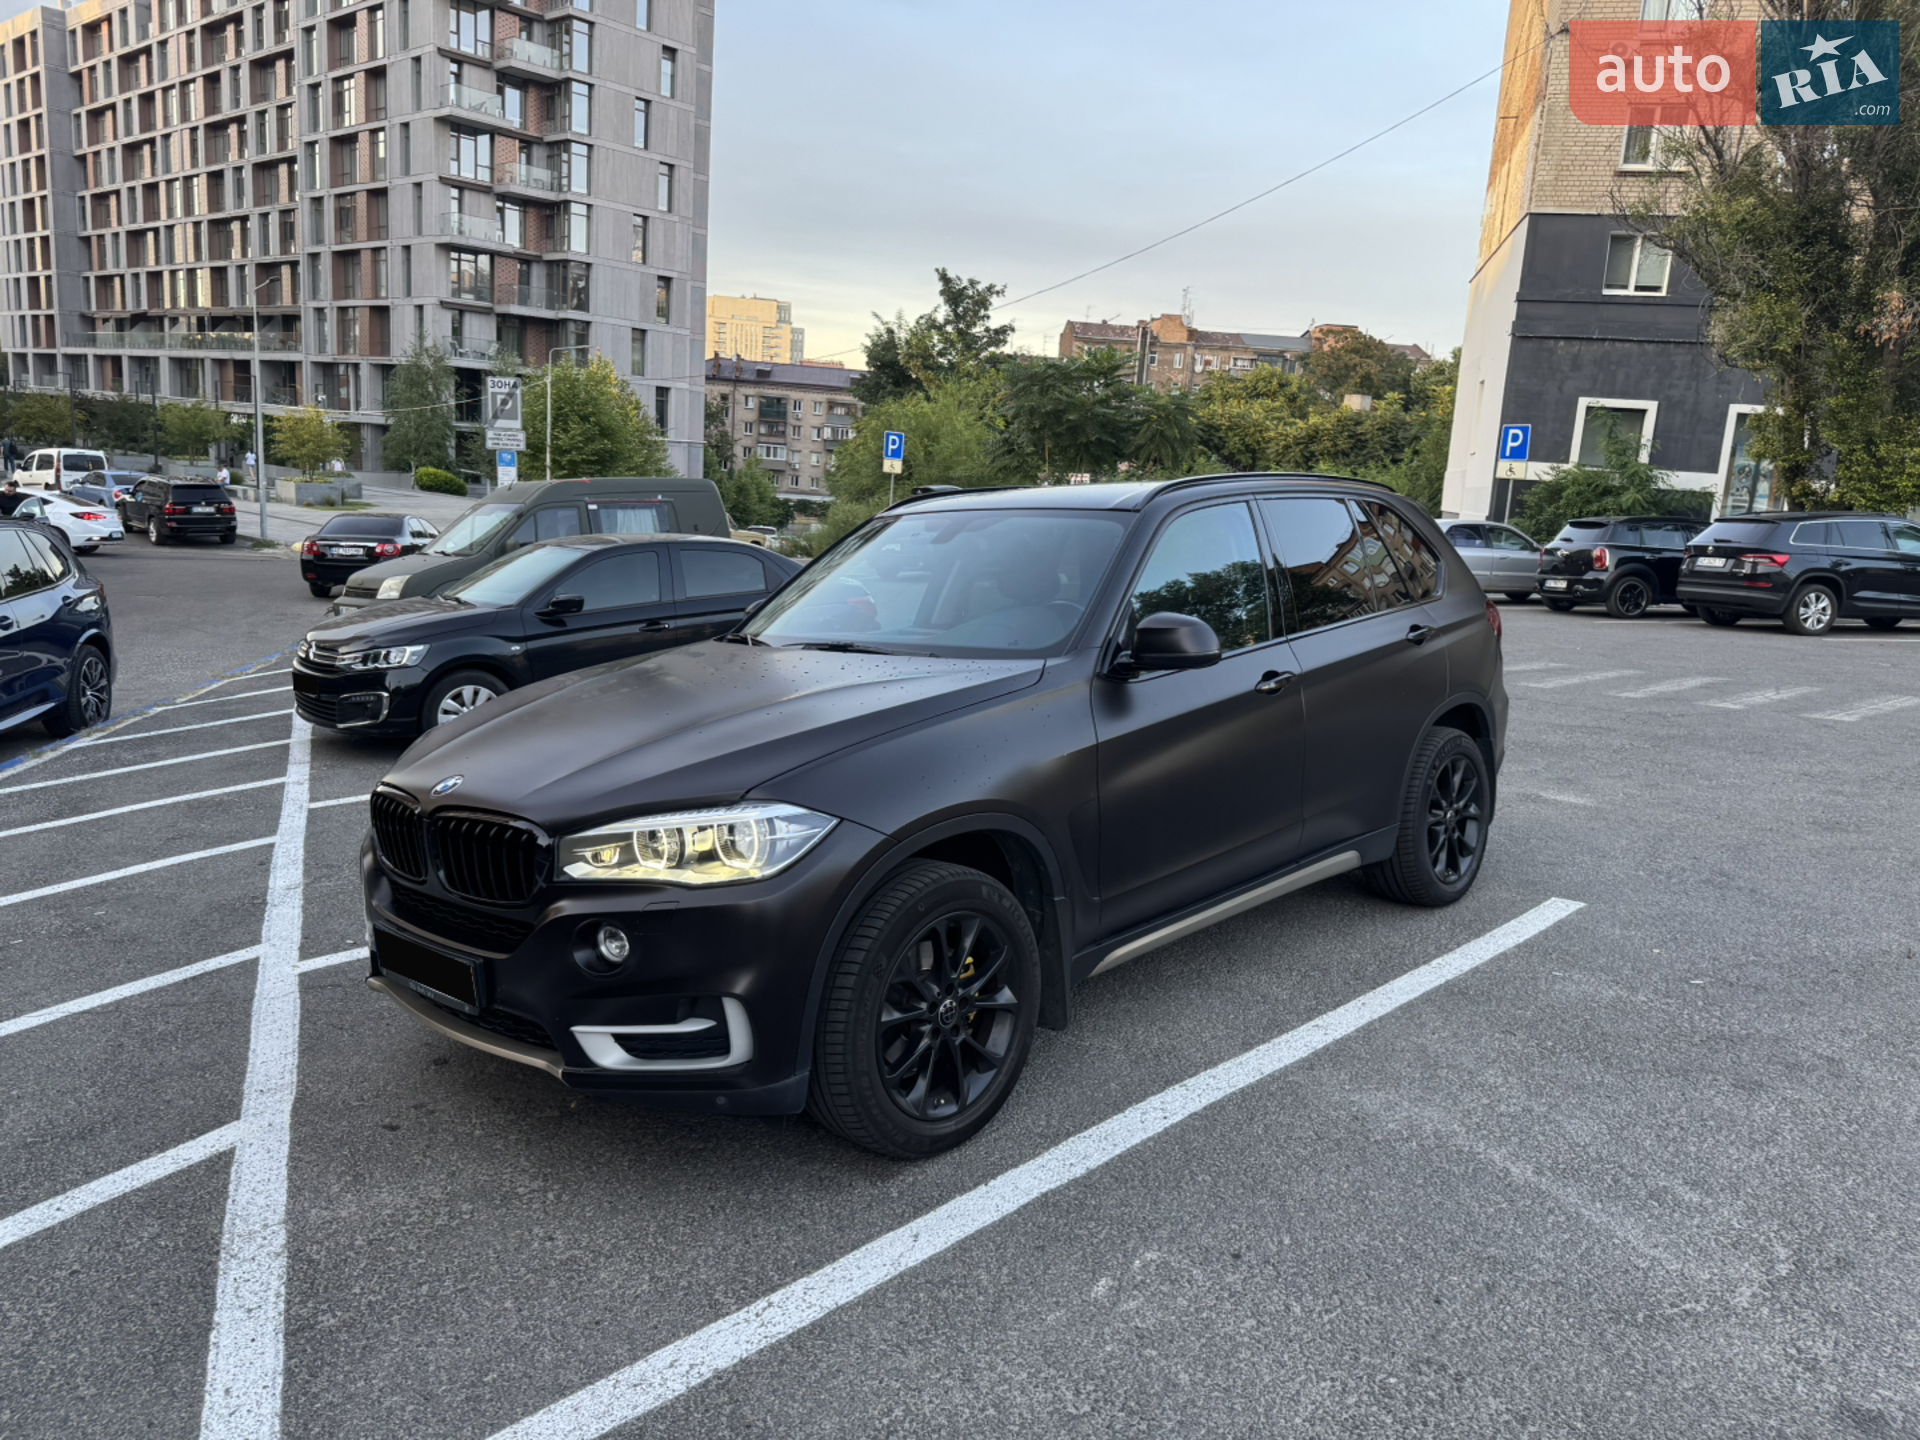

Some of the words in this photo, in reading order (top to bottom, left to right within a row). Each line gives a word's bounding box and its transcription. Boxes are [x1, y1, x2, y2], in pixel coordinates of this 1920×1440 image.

[490, 379, 518, 389] ЗОНА
[887, 435, 900, 457] P
[1505, 428, 1524, 457] P
